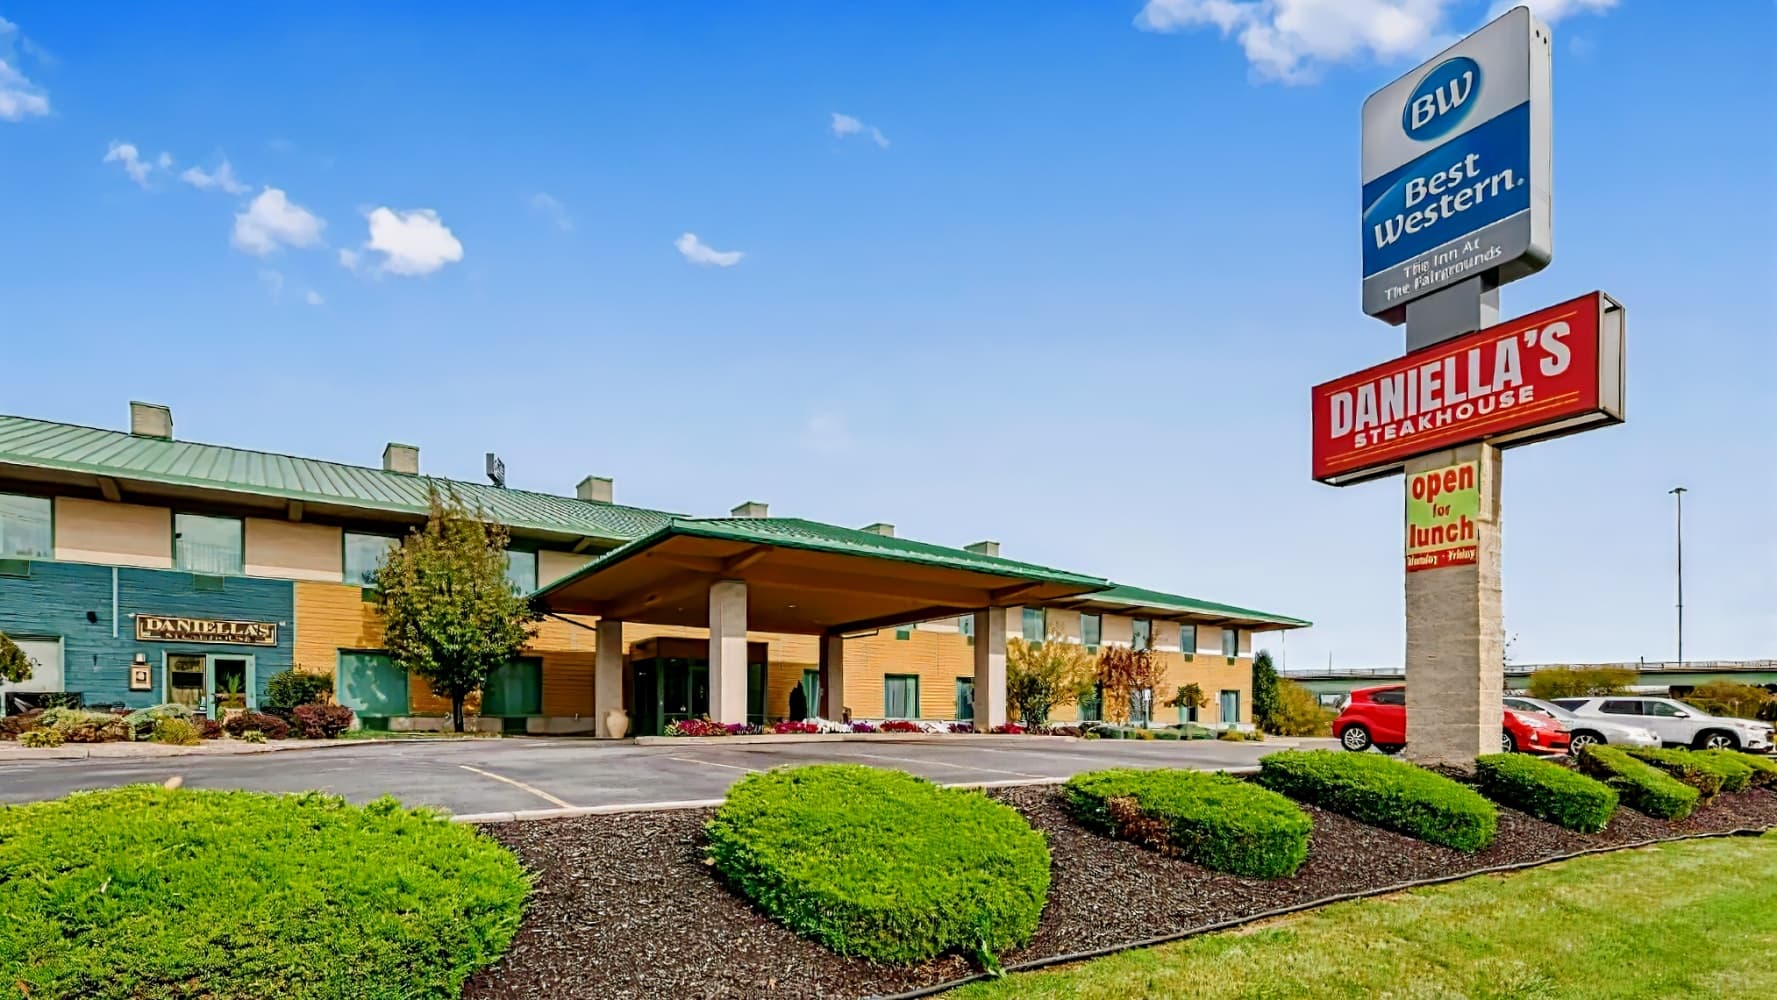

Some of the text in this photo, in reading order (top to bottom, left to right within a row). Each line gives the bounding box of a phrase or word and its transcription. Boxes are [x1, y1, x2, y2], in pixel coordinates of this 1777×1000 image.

[1411, 71, 1473, 131] BW
[1405, 152, 1480, 209] Best
[1403, 259, 1430, 279] The
[1434, 248, 1458, 267] Inn
[1384, 283, 1410, 301] The
[1330, 321, 1571, 439] DANIELLA'S
[1354, 385, 1534, 449] STEAKHOUSE
[1412, 465, 1474, 504] open
[1433, 503, 1451, 518] for
[1409, 514, 1474, 548] lunch
[146, 619, 270, 636] DANIELLA'S
